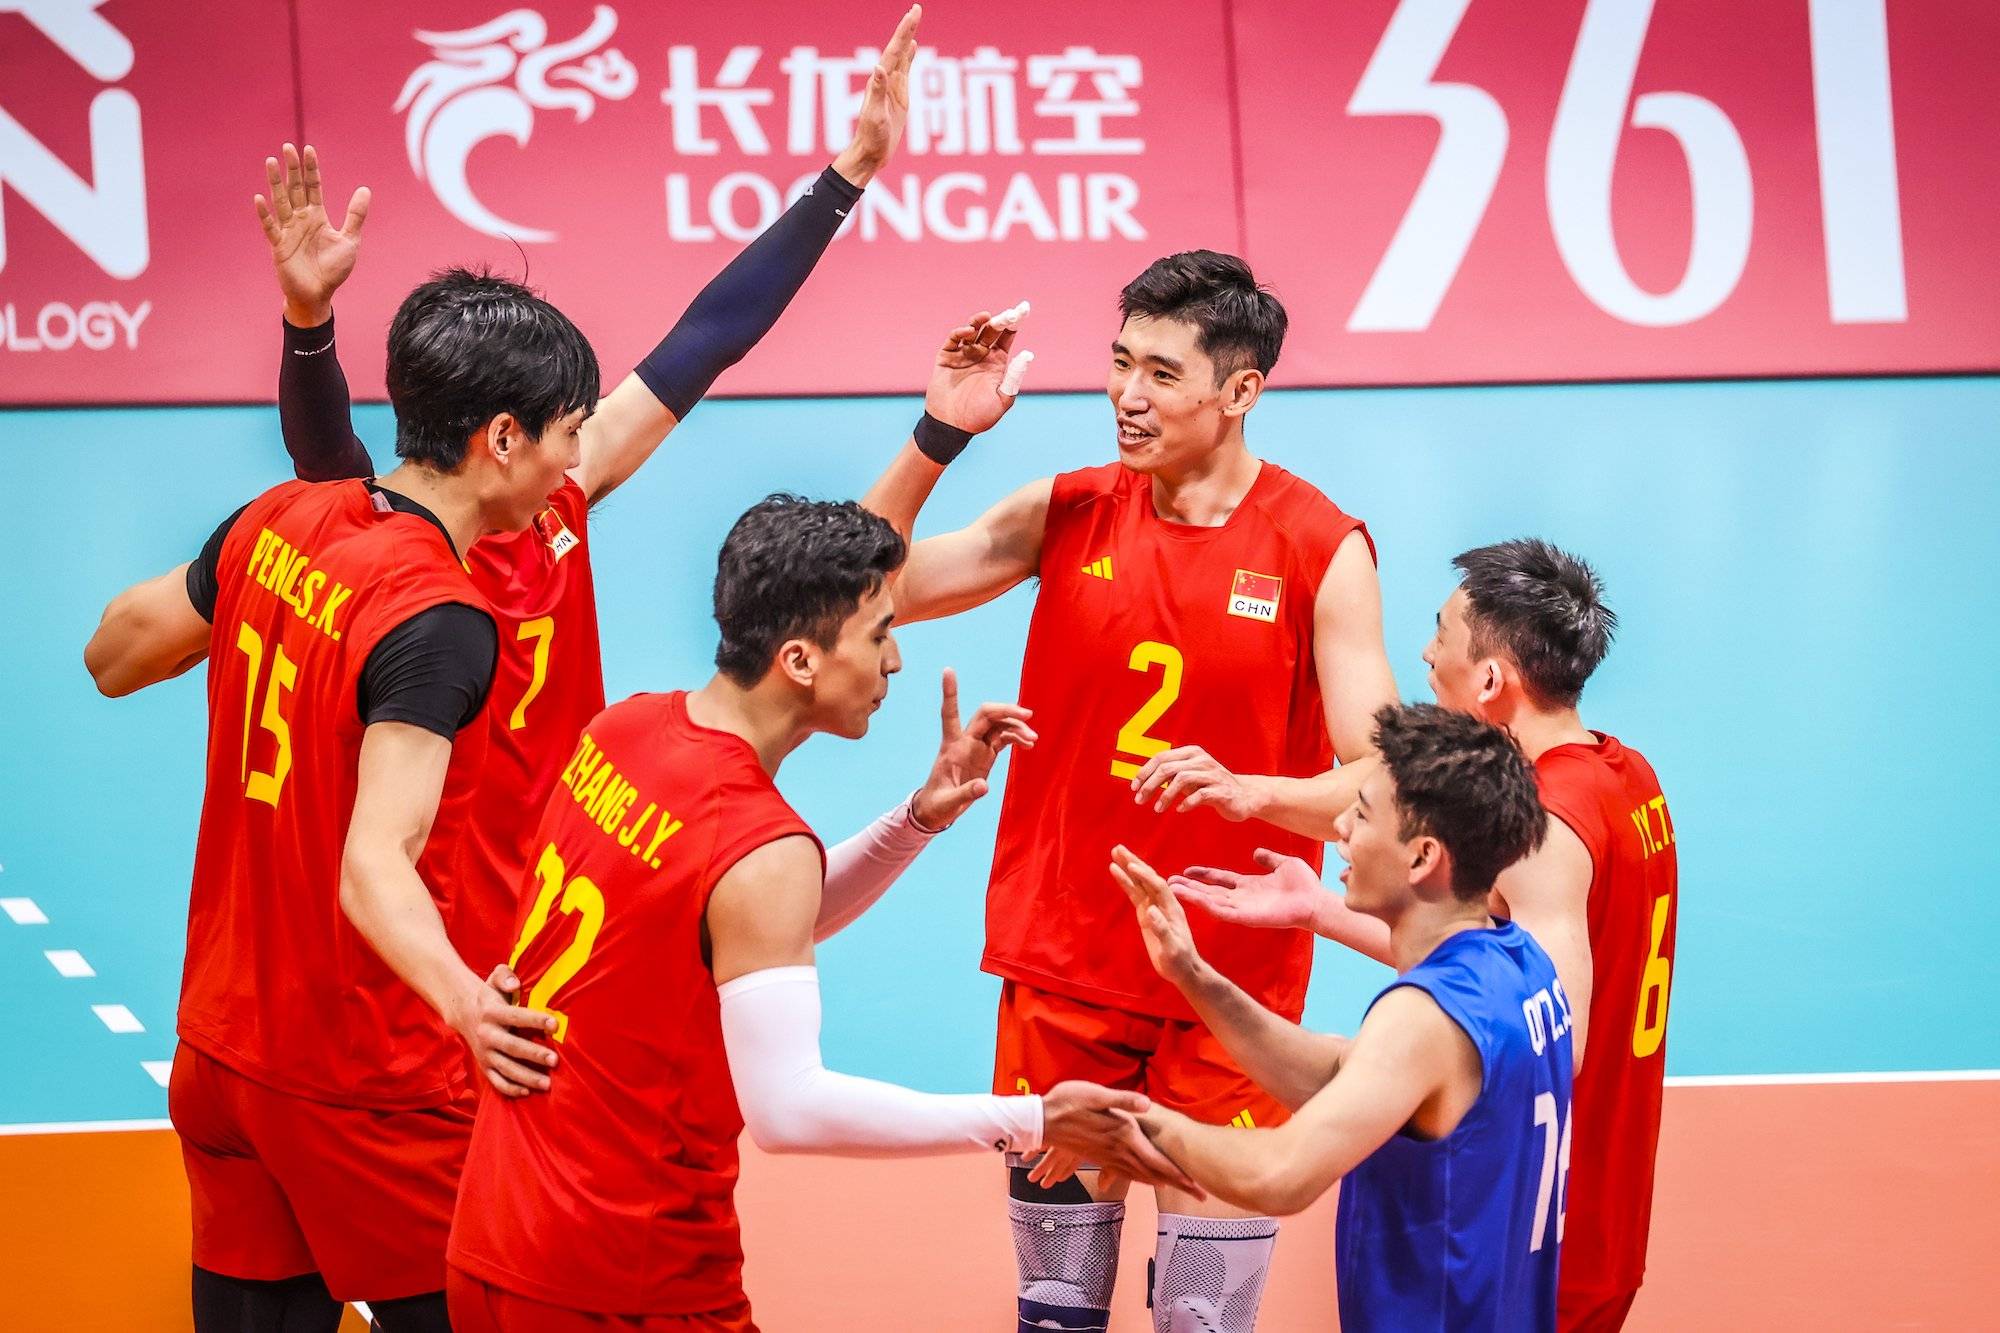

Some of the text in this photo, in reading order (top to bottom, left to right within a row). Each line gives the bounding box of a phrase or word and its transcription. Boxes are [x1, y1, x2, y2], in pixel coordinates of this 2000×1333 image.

[0, 300, 151, 351] LOGY
[1234, 600, 1271, 617] CHN
[236, 621, 298, 811] 15
[509, 616, 554, 731] 7
[1115, 640, 1184, 759] 2
[561, 733, 684, 870] ZHANG J.Y.
[508, 842, 605, 1044] 22
[1632, 893, 1670, 1058] 6
